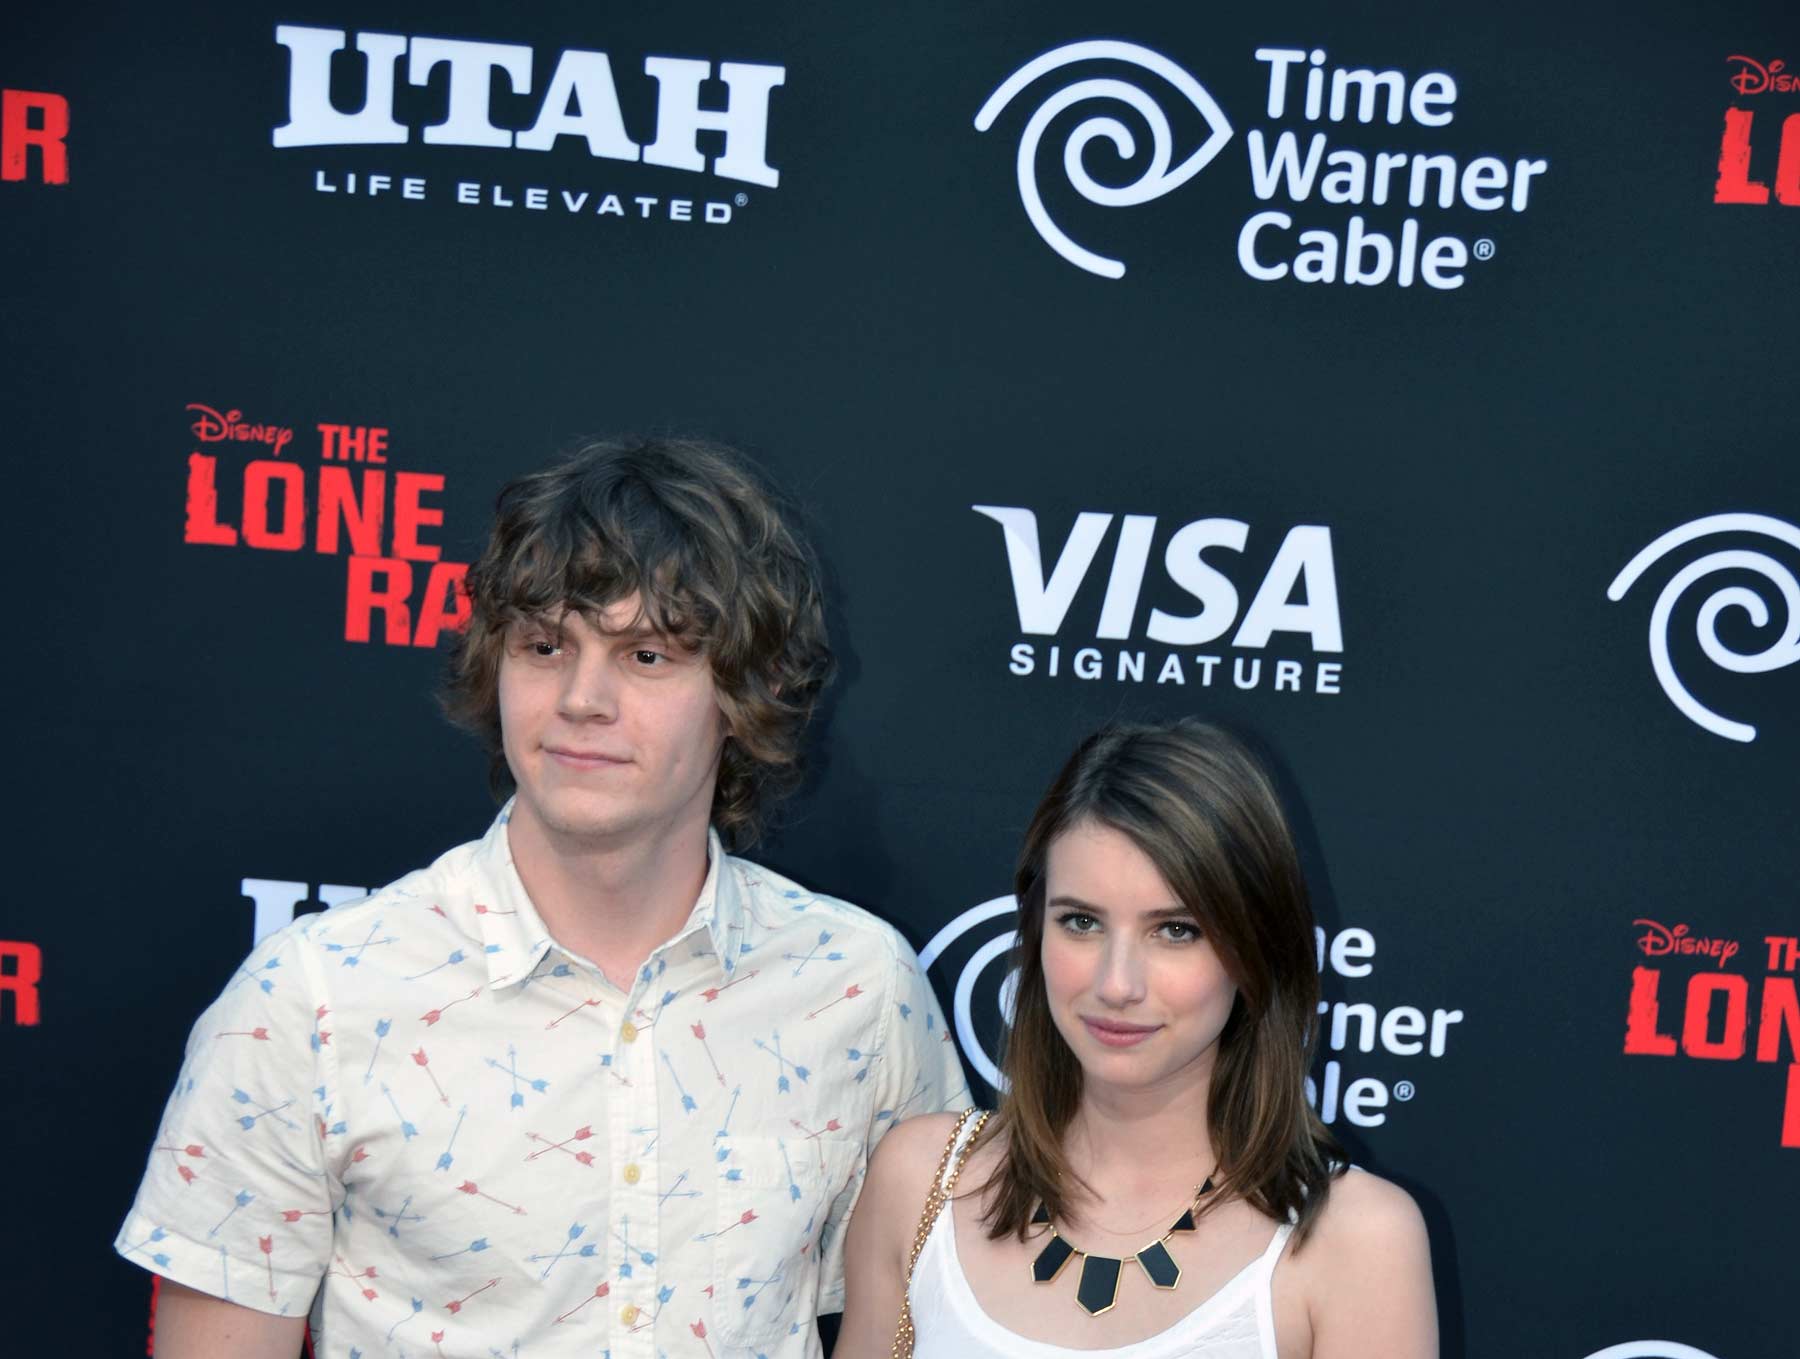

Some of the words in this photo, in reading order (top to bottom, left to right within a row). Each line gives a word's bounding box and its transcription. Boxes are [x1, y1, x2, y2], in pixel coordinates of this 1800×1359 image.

[272, 24, 786, 189] UTAH
[1254, 48, 1458, 127] Time
[316, 170, 426, 200] LIFE
[1247, 129, 1548, 213] Warner
[317, 423, 389, 464] THE
[184, 451, 446, 562] LONE
[971, 504, 1344, 653] VISA
[1009, 643, 1343, 694] SIGNATURE
